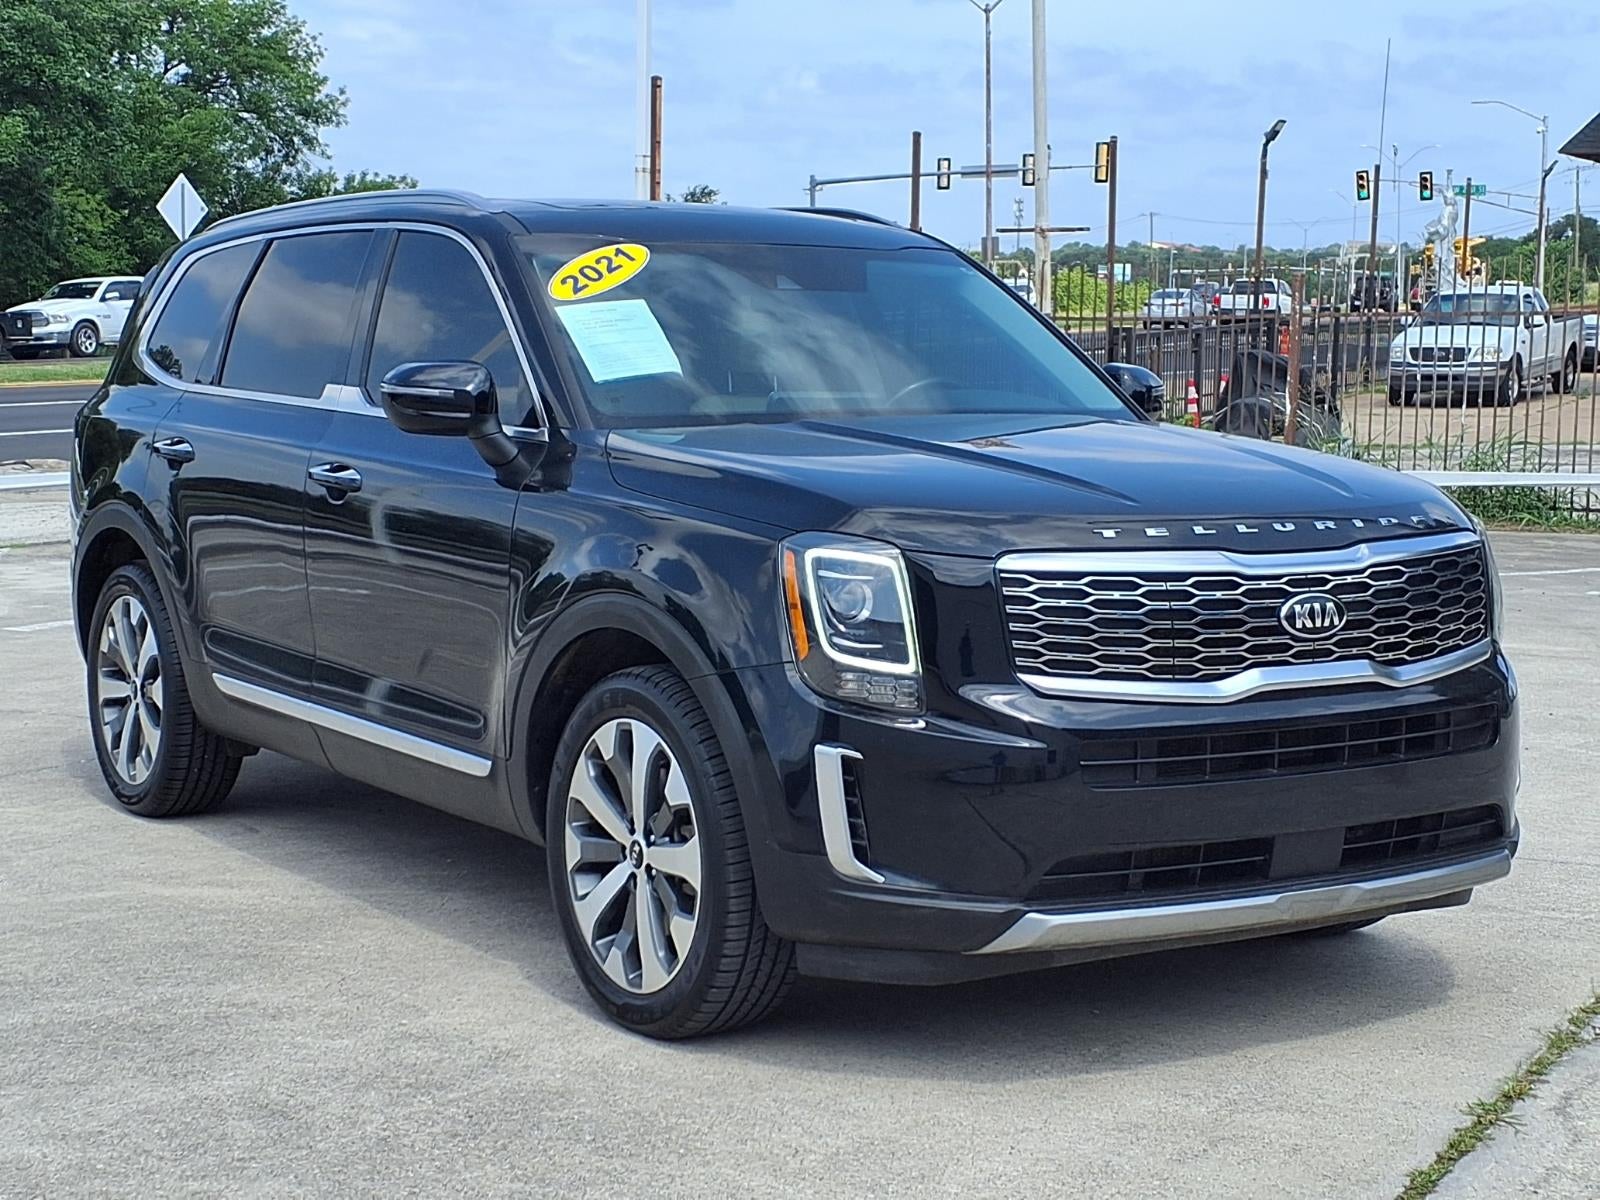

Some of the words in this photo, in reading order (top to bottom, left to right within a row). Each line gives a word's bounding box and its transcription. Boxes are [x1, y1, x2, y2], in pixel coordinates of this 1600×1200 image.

[560, 247, 636, 295] 2021
[1093, 515, 1429, 539] TELLURIDE
[1293, 602, 1340, 629] KIA
